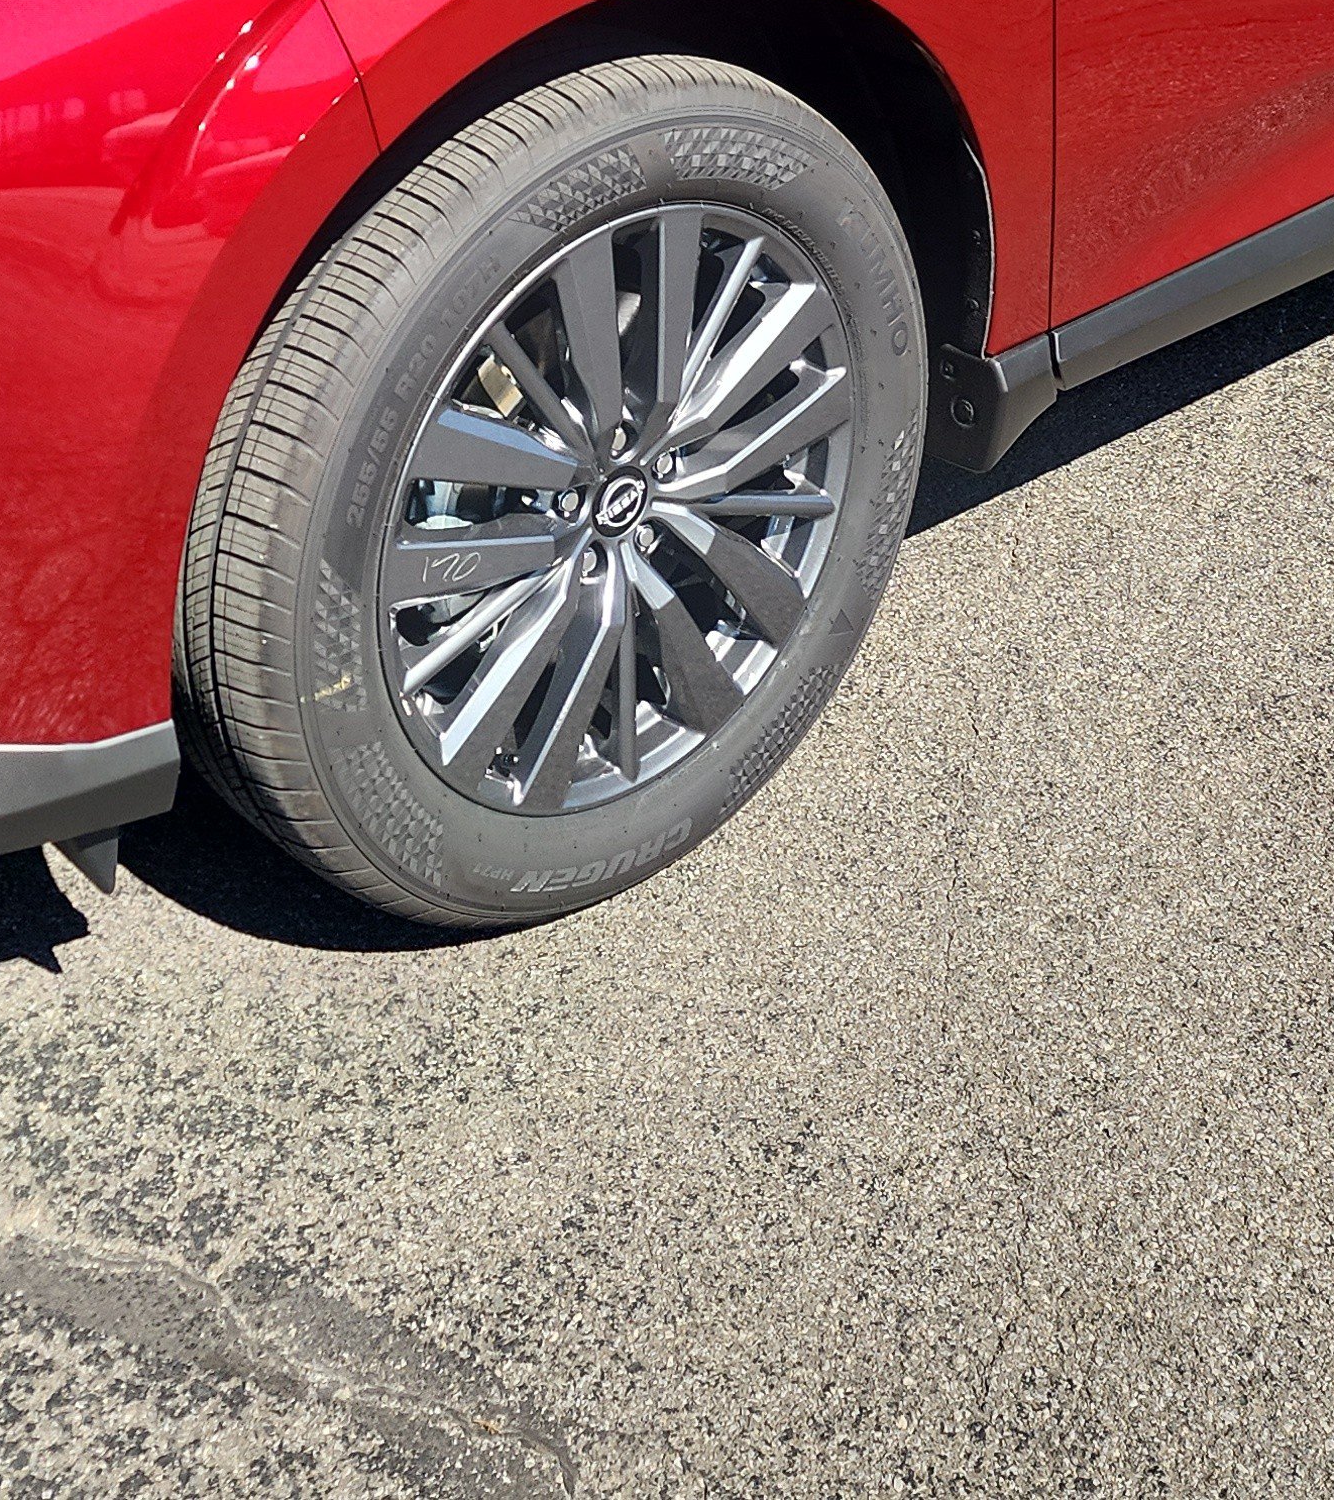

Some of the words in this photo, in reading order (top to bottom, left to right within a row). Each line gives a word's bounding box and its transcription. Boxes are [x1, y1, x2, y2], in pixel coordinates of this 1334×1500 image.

[835, 202, 909, 358] KUMHO
[346, 406, 400, 530] 255/55
[394, 333, 437, 401] R20
[595, 480, 646, 525] NISSAN
[510, 817, 693, 893] CRUGEN
